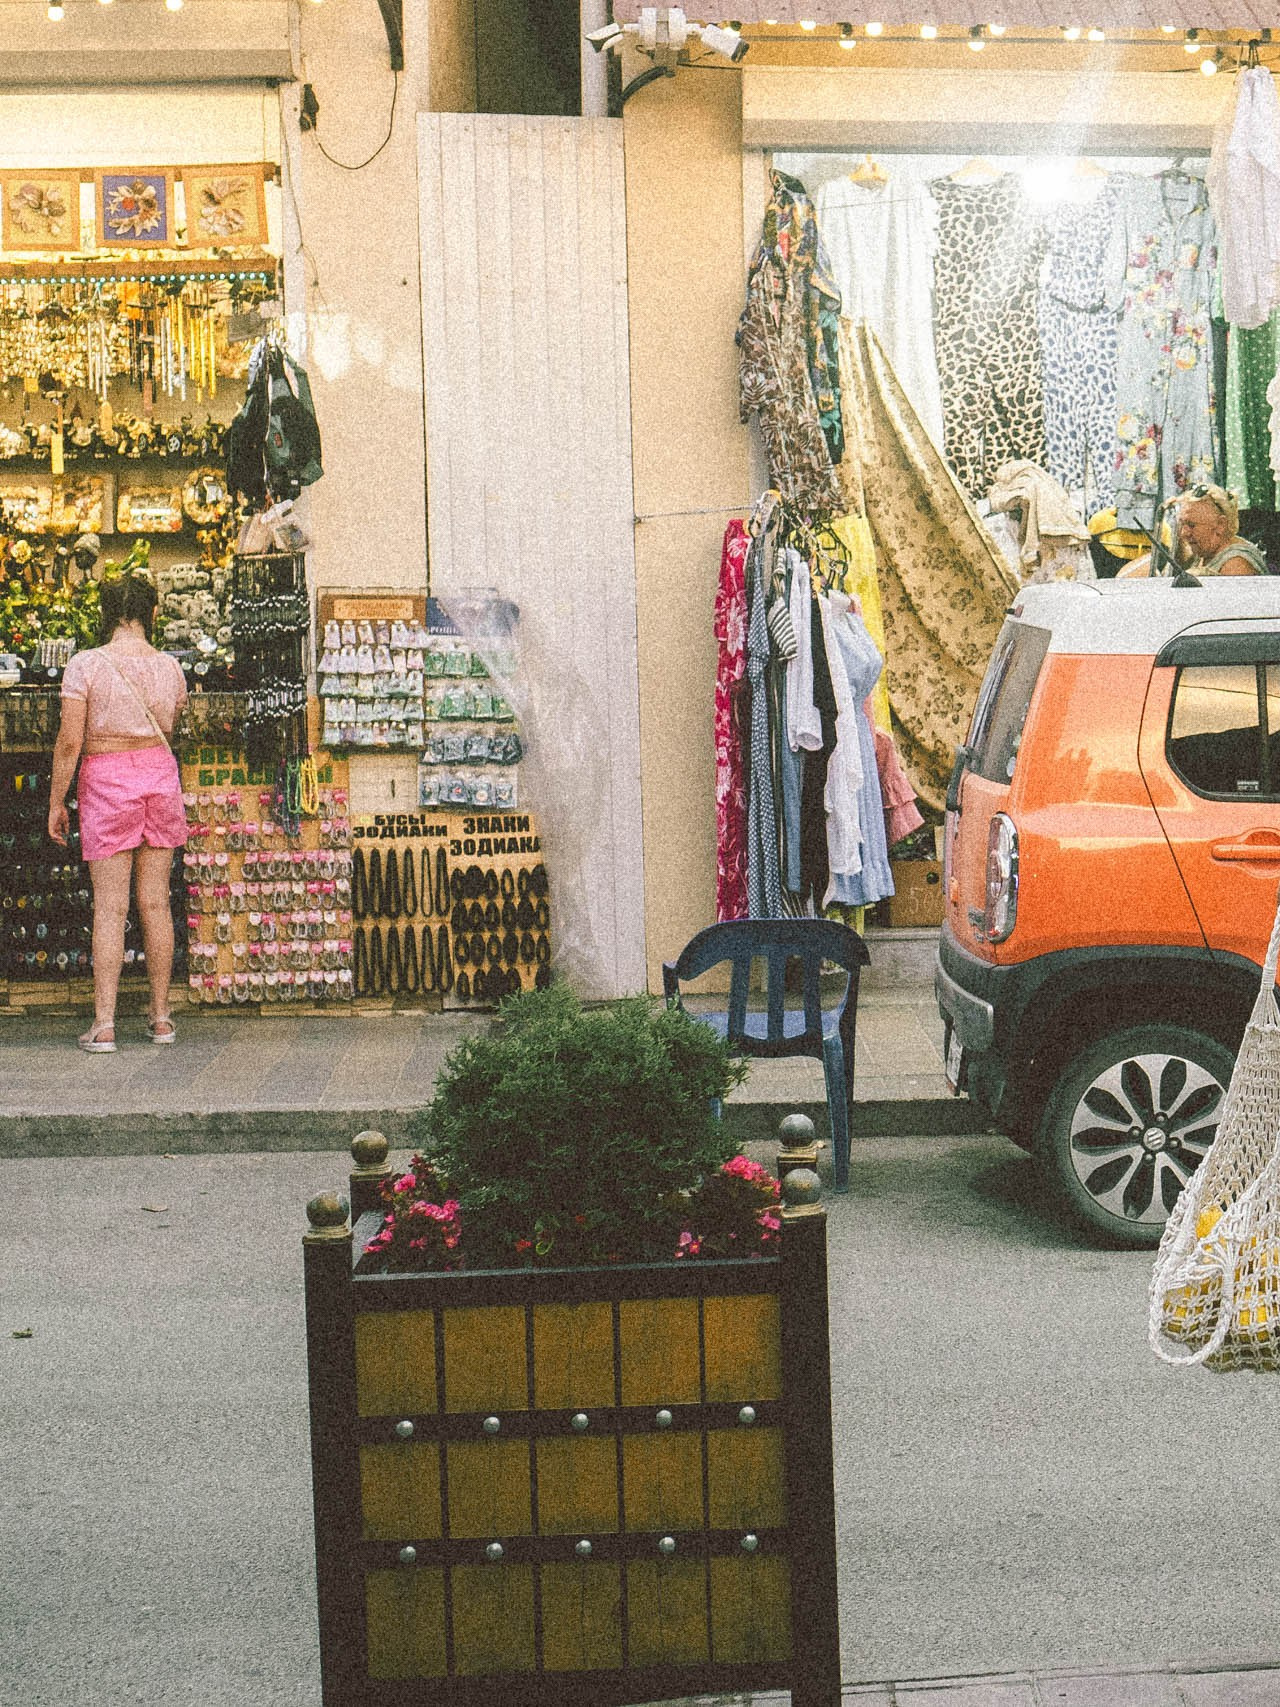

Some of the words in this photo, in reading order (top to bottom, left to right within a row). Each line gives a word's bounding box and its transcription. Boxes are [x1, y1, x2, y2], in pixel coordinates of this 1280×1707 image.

[374, 814, 426, 826] БУСЫ
[463, 815, 530, 834] ЗНАКИ
[353, 825, 448, 840] ЗОДИАКИ
[450, 836, 541, 857] ЗОДИАКА
